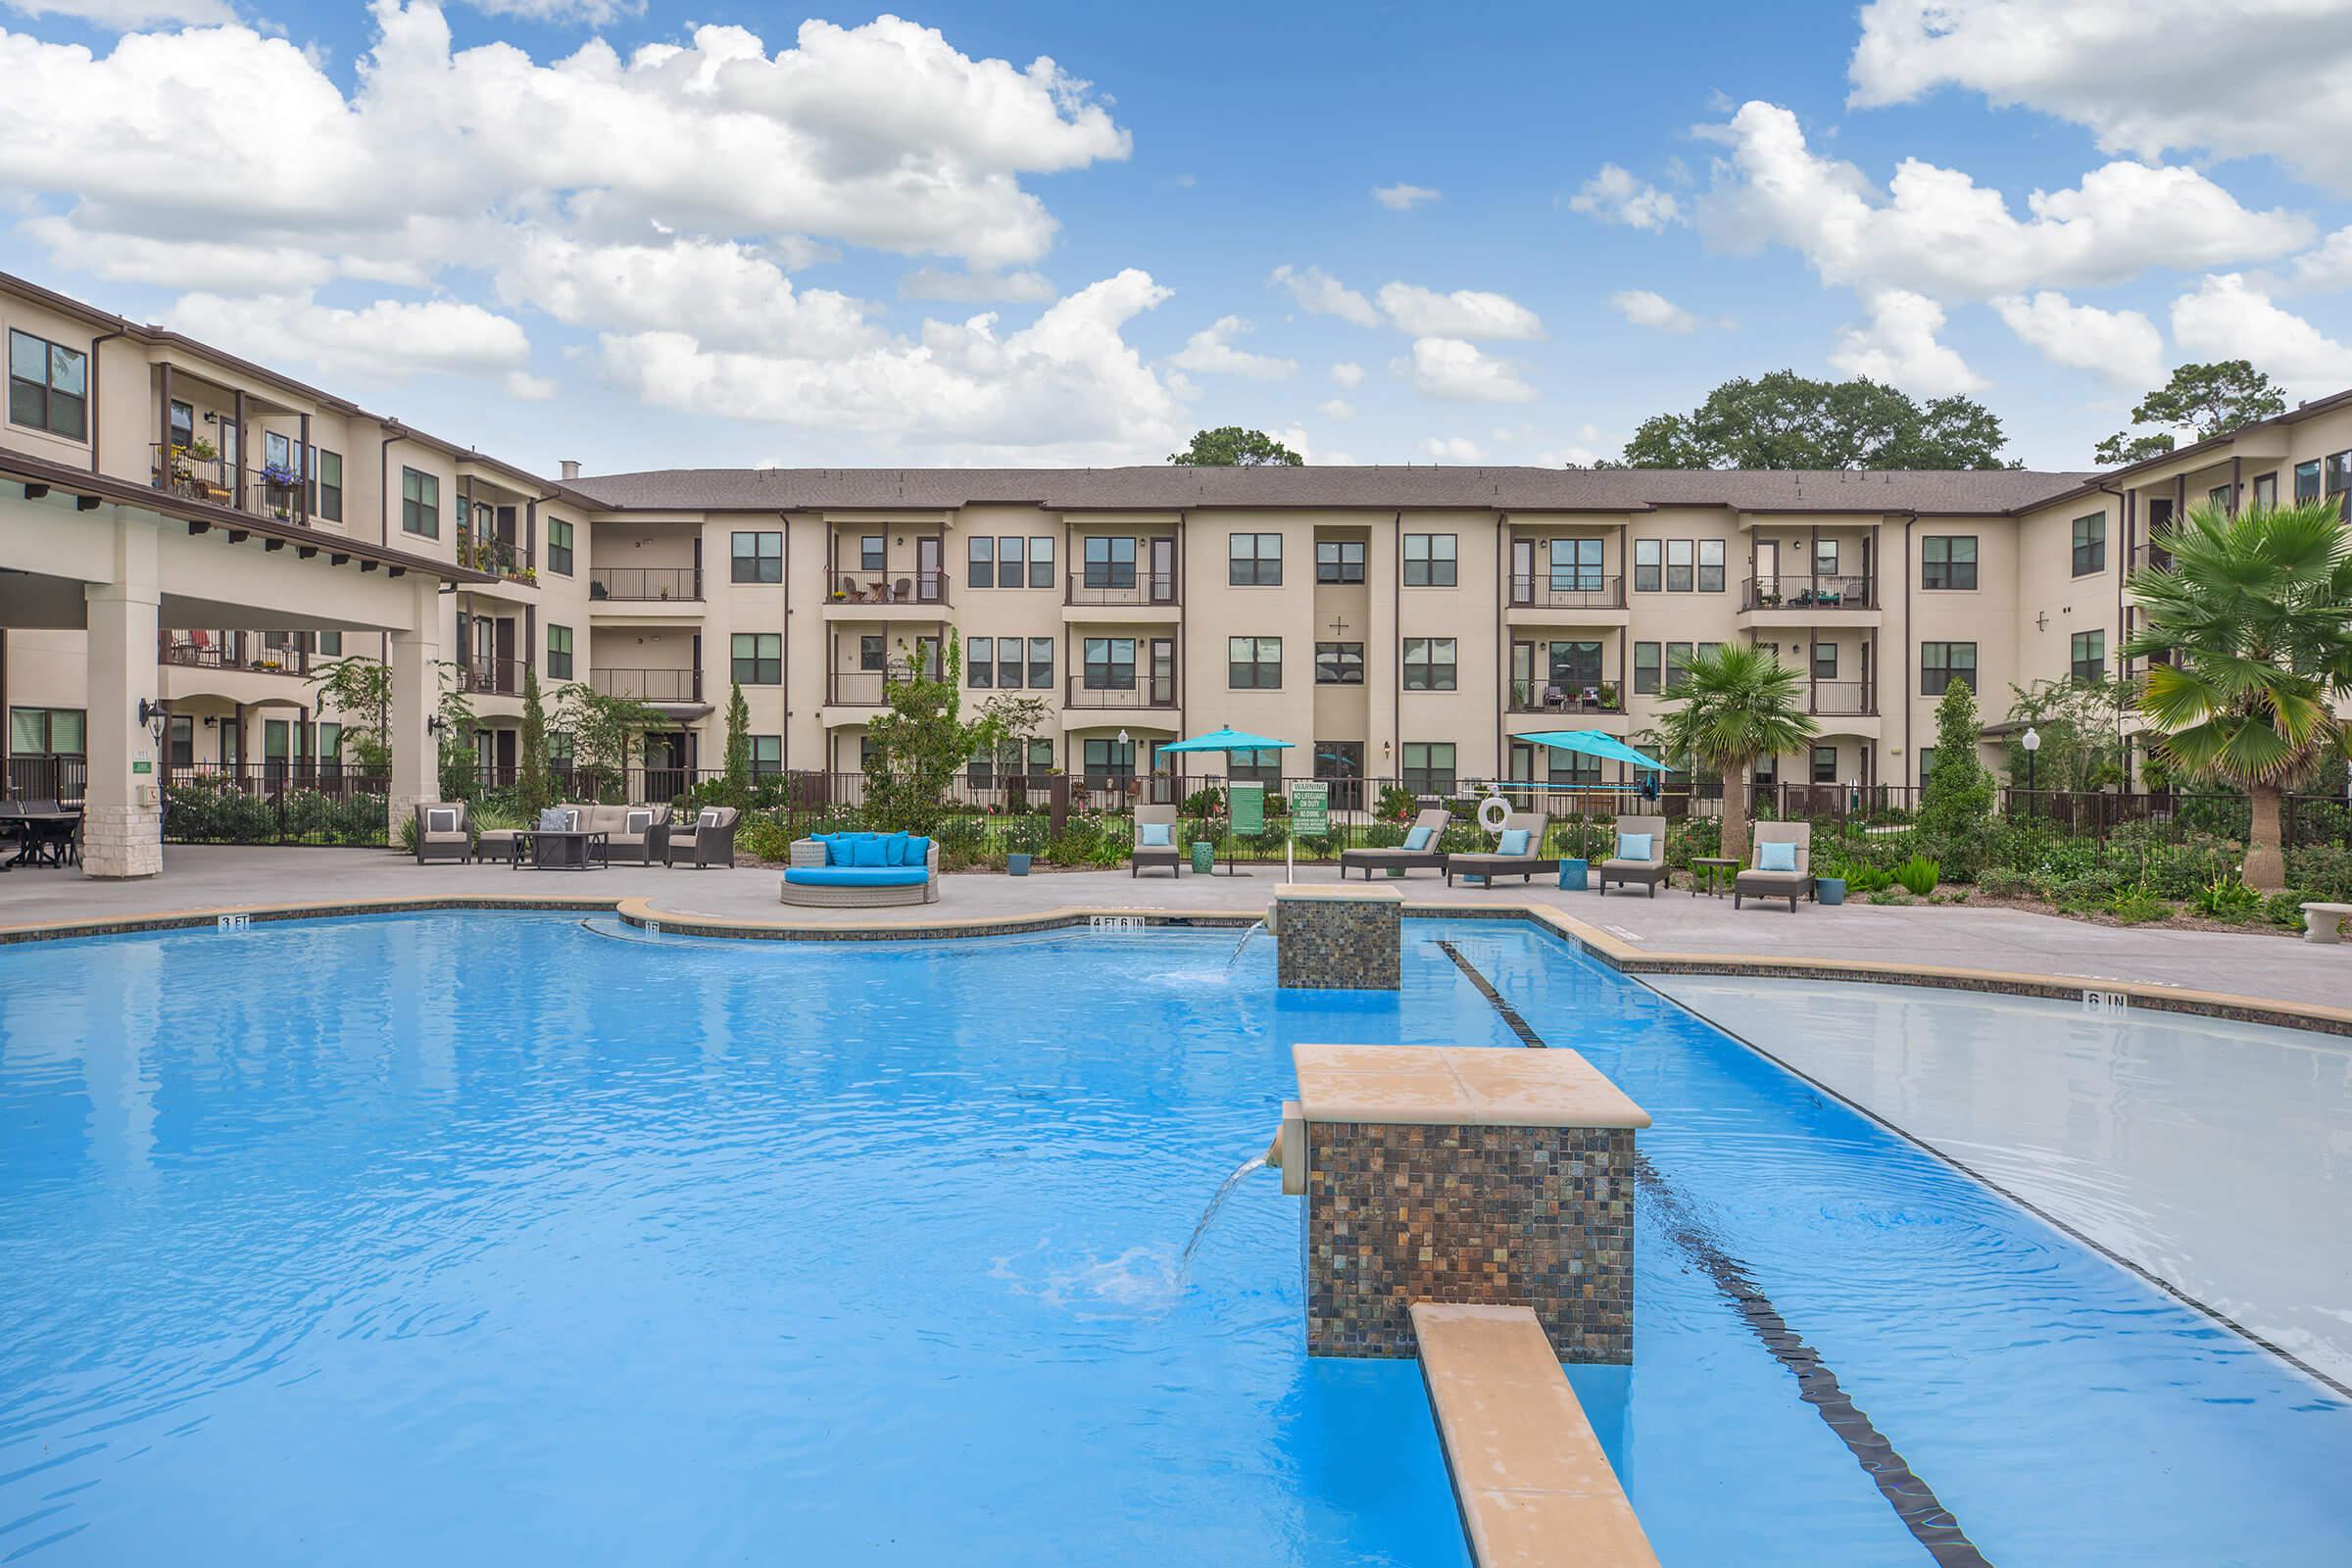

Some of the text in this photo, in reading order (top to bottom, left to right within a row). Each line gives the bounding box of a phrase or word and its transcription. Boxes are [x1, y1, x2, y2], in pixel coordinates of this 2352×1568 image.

[1301, 792, 1326, 801] LIFEGUARD
[222, 915, 248, 927] 3 FT
[1094, 917, 1144, 927] 4 FT 6 IN
[2088, 993, 2125, 1006] 6 IN
